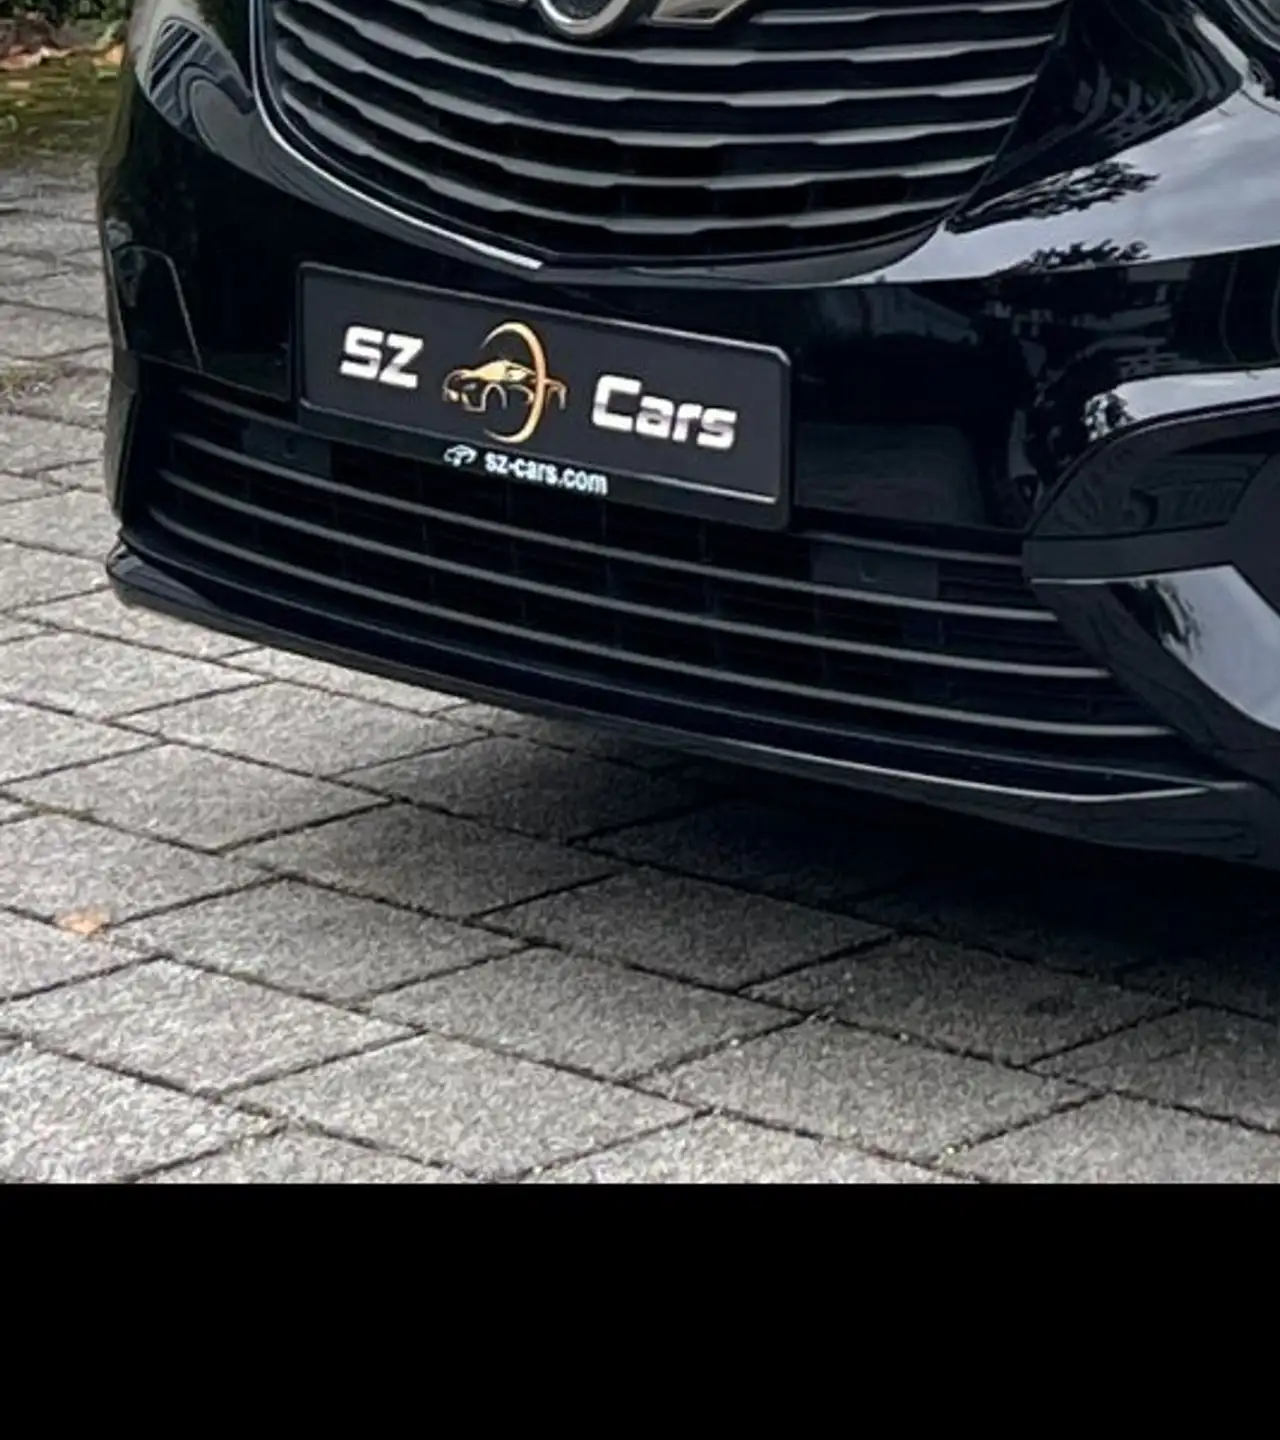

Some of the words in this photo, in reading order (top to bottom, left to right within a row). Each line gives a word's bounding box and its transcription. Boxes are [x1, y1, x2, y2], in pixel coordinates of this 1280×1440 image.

[339, 325, 424, 389] SZ
[591, 374, 738, 450] Cars
[484, 450, 609, 496] sz-cars.com
